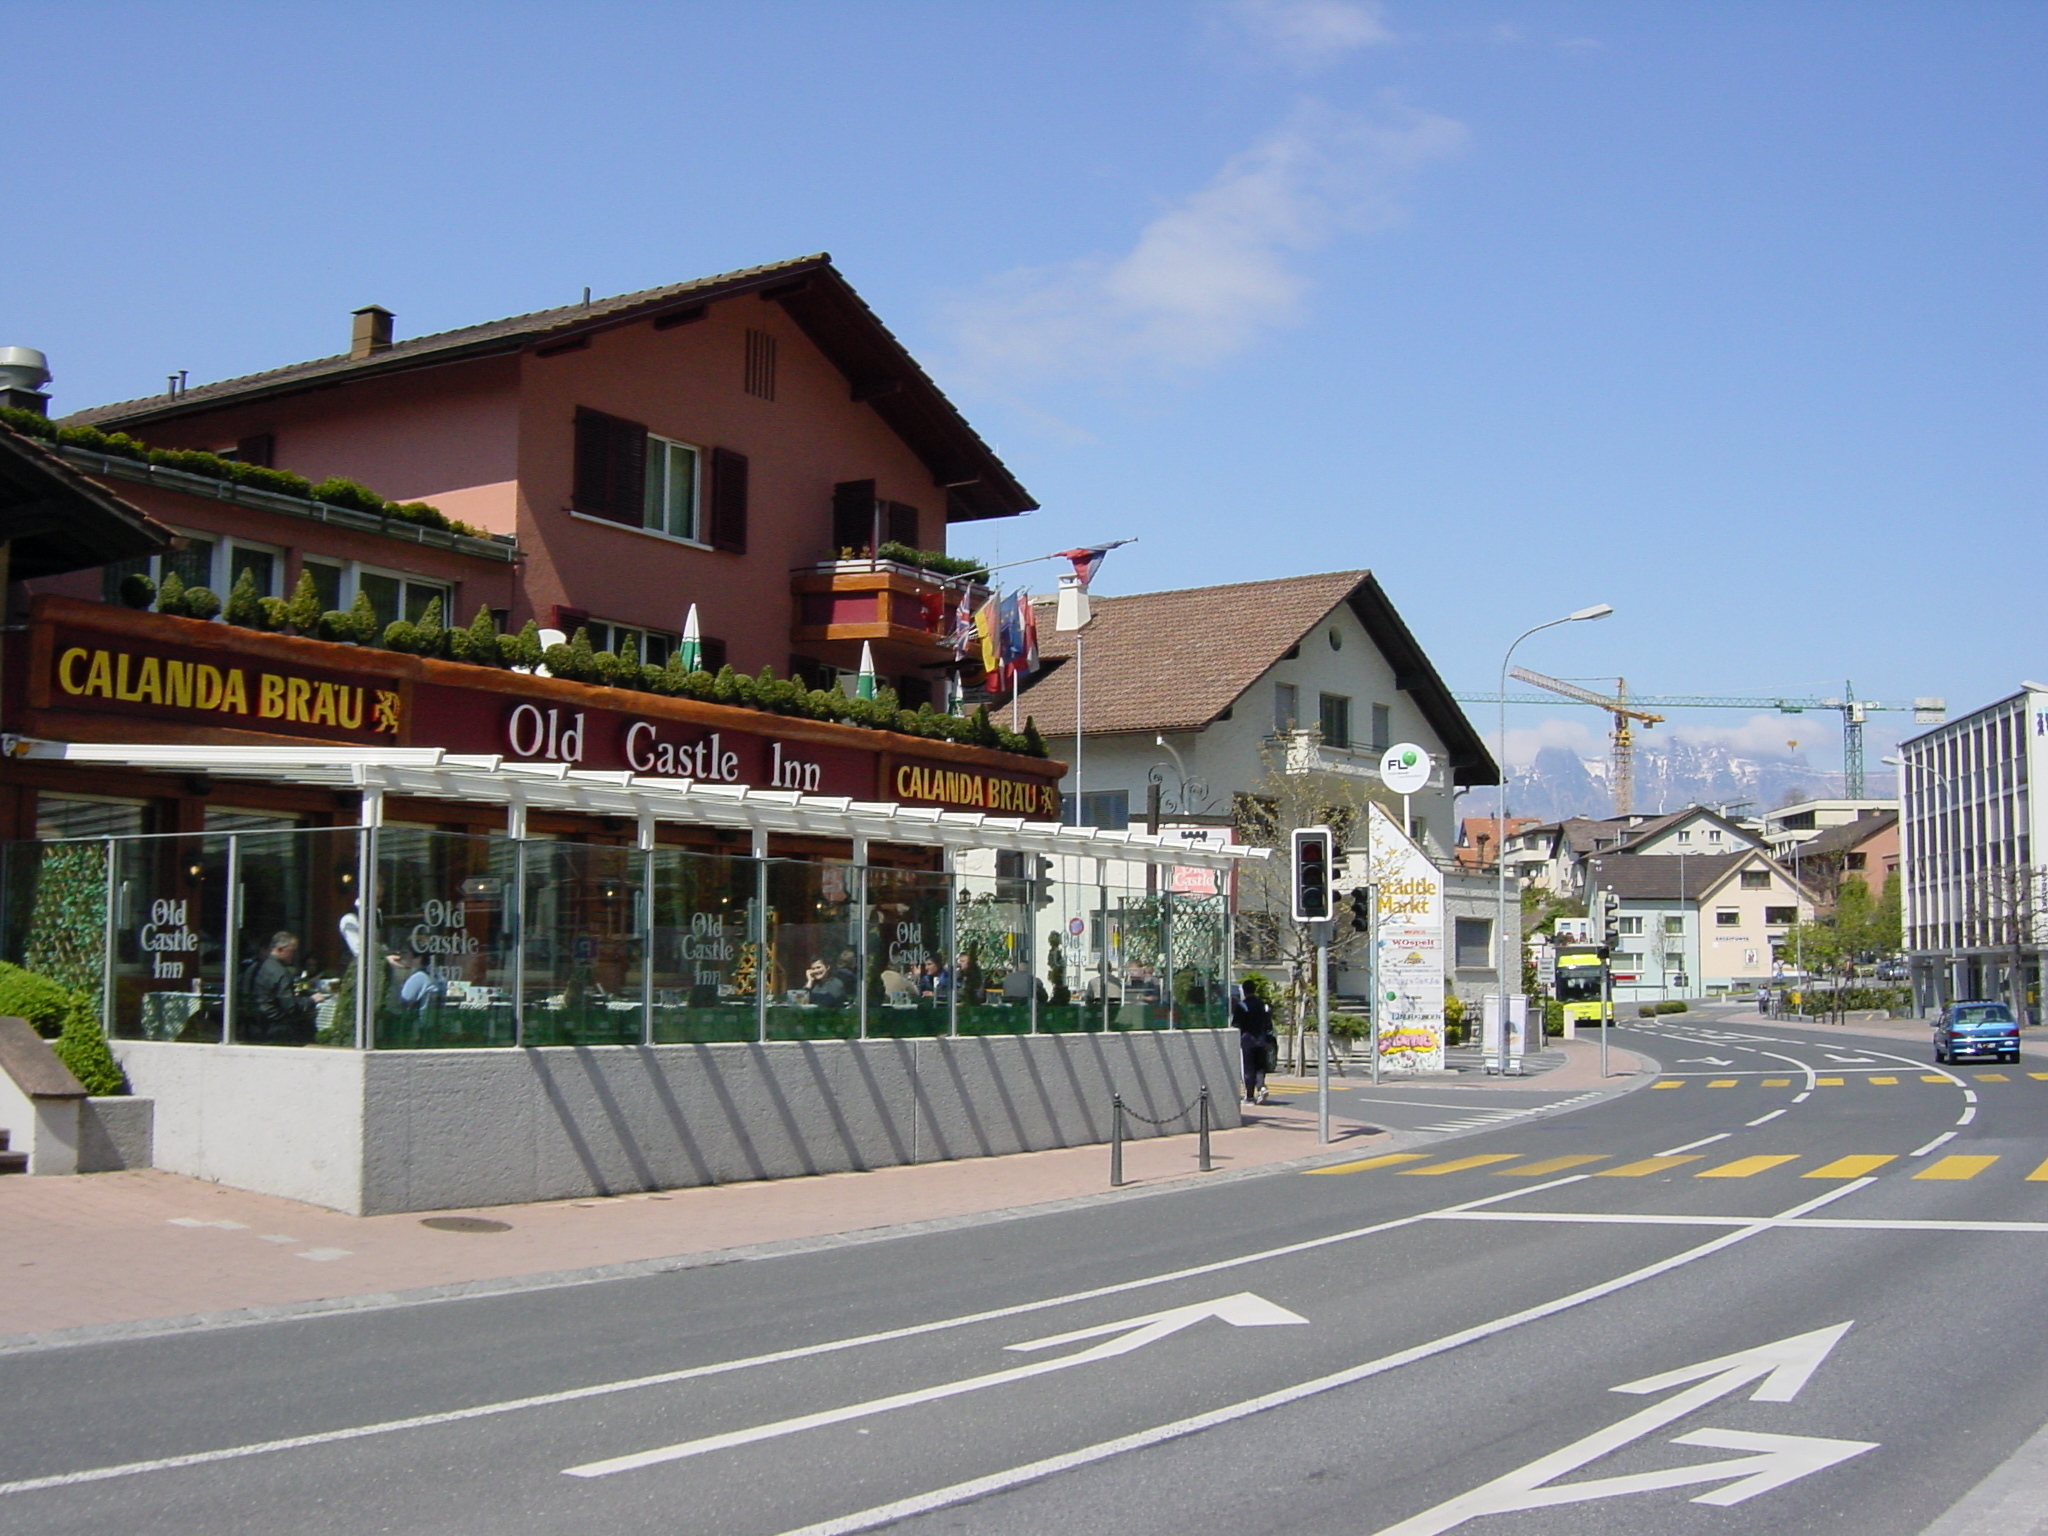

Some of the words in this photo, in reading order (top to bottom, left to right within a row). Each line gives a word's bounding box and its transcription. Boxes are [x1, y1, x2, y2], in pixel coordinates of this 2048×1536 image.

[59, 647, 248, 715] CALANDA
[260, 673, 363, 729] BRÄU
[509, 704, 585, 762] Old
[626, 722, 738, 782] Castle
[771, 742, 821, 791] Inn
[897, 765, 983, 807] CALANDA
[988, 778, 1036, 813] BRÄU
[152, 898, 187, 926] Old
[424, 899, 465, 928] Old
[1378, 896, 1429, 914] Markt
[141, 923, 198, 951] Castle
[692, 912, 723, 937] Old
[897, 921, 921, 943] Old
[411, 924, 478, 954] Castle
[682, 934, 733, 960] Castle
[889, 941, 930, 964] Castle
[153, 951, 183, 978] Inn
[694, 960, 720, 985] Inn
